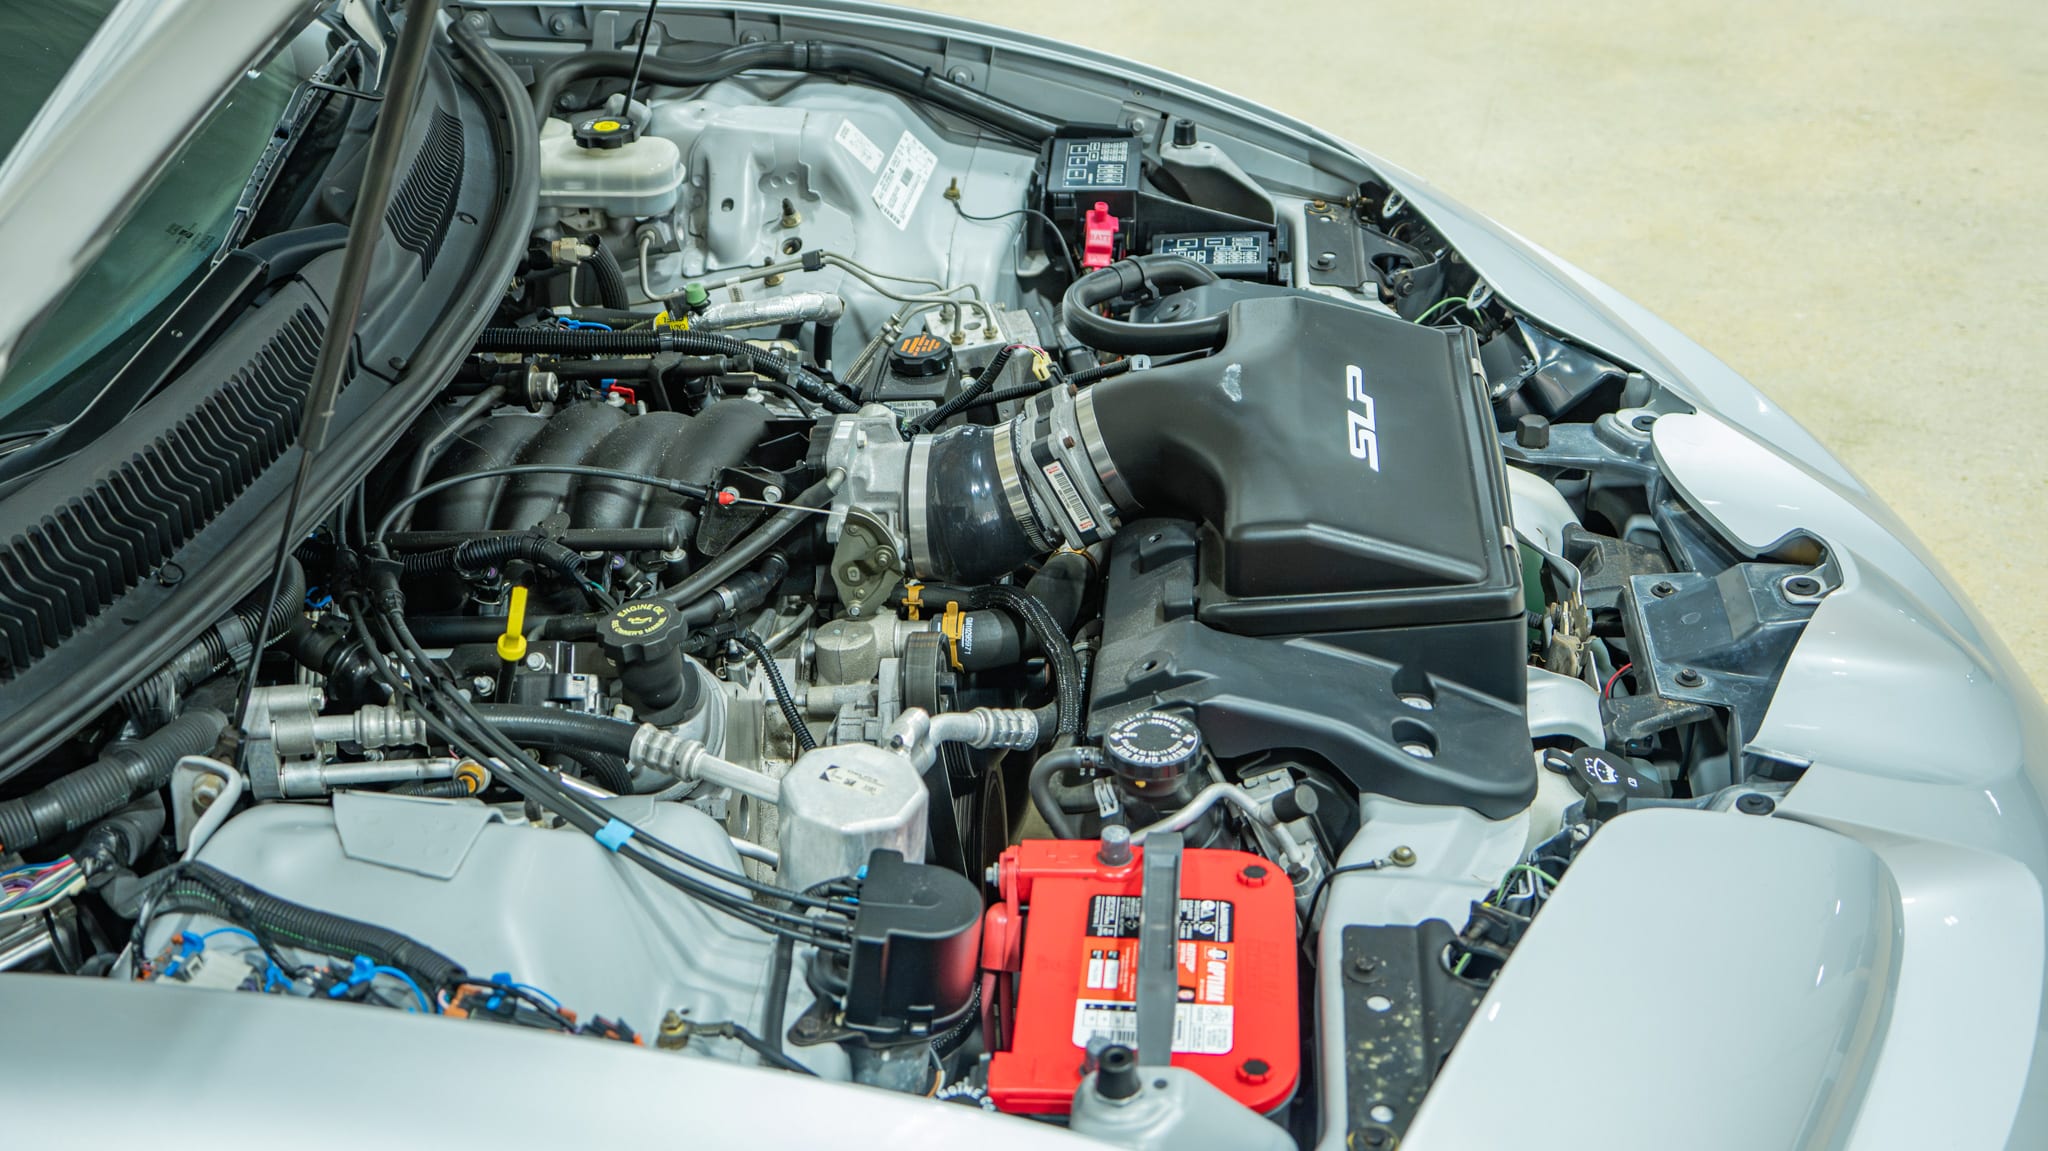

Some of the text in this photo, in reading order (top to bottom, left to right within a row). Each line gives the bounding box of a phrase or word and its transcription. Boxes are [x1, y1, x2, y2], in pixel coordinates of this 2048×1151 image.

[1346, 365, 1379, 472] SLP
[617, 604, 654, 617] ENGINE
[1132, 754, 1158, 764] OPEN
[1207, 962, 1226, 1002] OPTIMA
